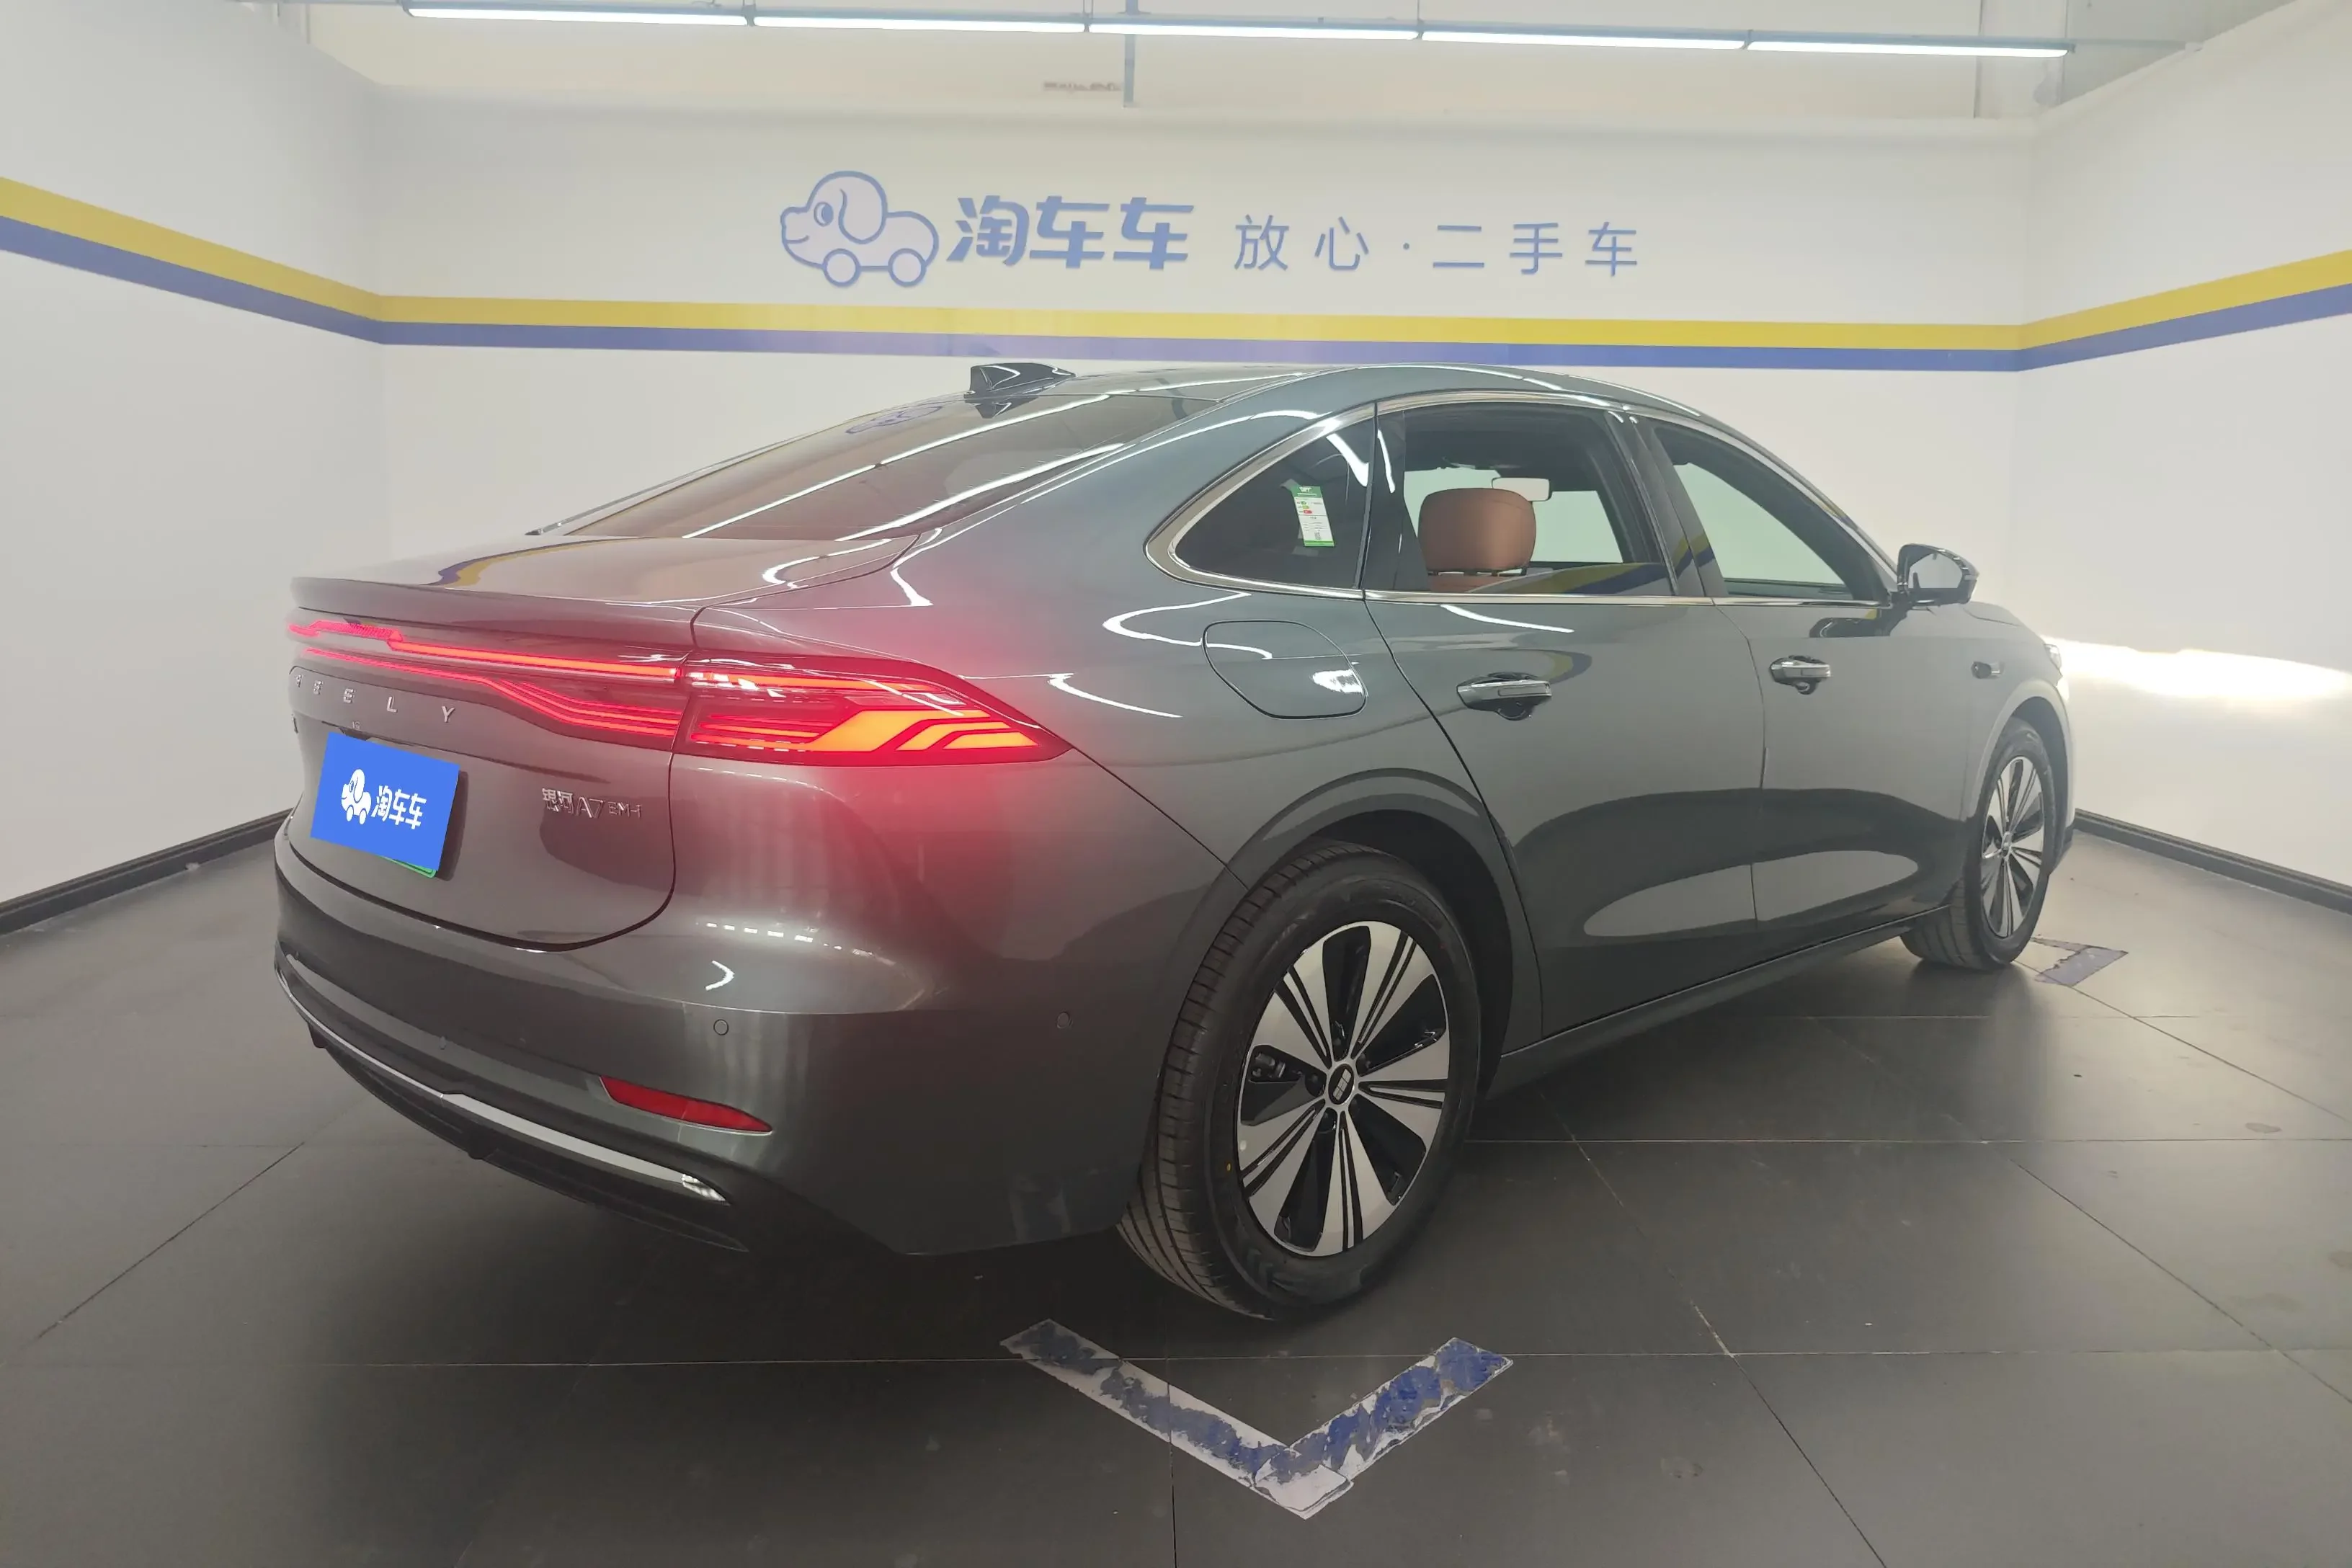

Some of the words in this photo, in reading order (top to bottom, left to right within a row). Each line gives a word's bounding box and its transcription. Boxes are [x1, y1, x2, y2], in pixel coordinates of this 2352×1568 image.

[945, 195, 1195, 270] 淘车车
[576, 796, 605, 819] A7
